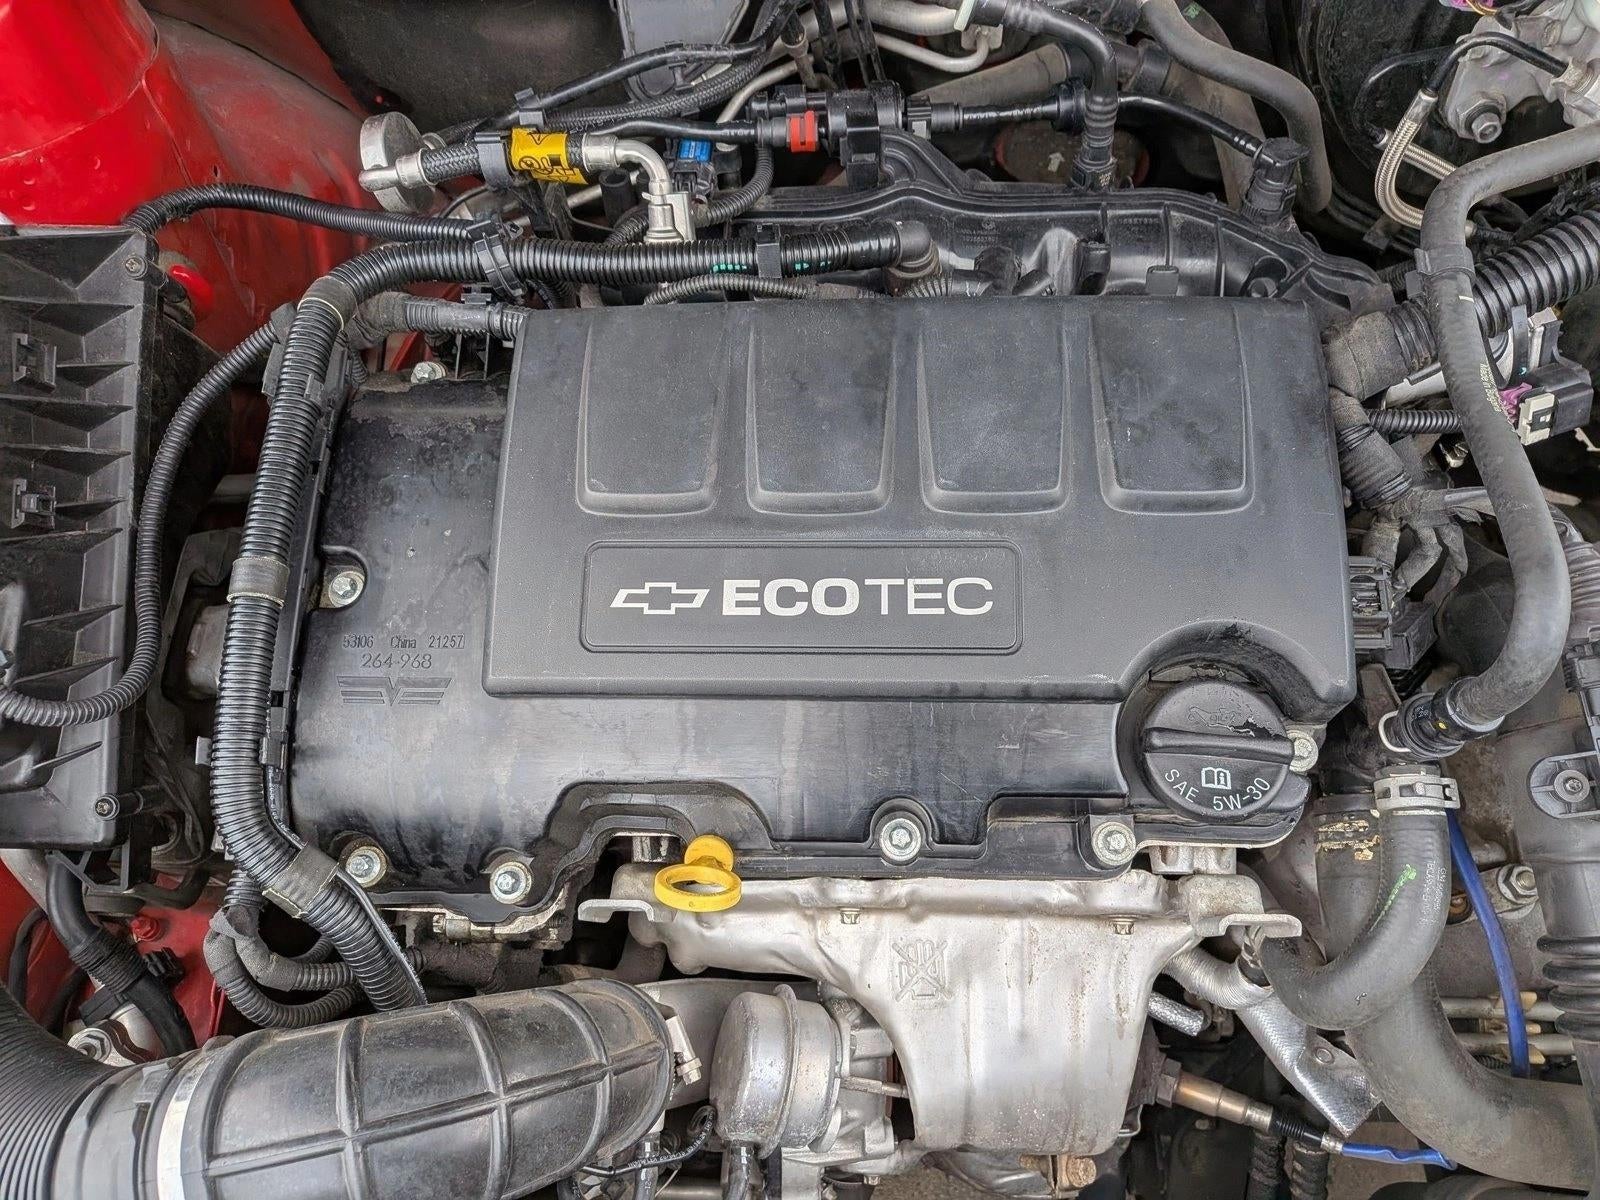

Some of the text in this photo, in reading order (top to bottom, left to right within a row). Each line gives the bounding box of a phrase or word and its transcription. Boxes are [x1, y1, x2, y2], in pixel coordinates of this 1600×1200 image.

[722, 577, 993, 616] ECOTEC
[343, 633, 465, 649] 53106 China 21257
[361, 652, 433, 670] 264-968
[1165, 769, 1271, 812] SAE 5W-30
